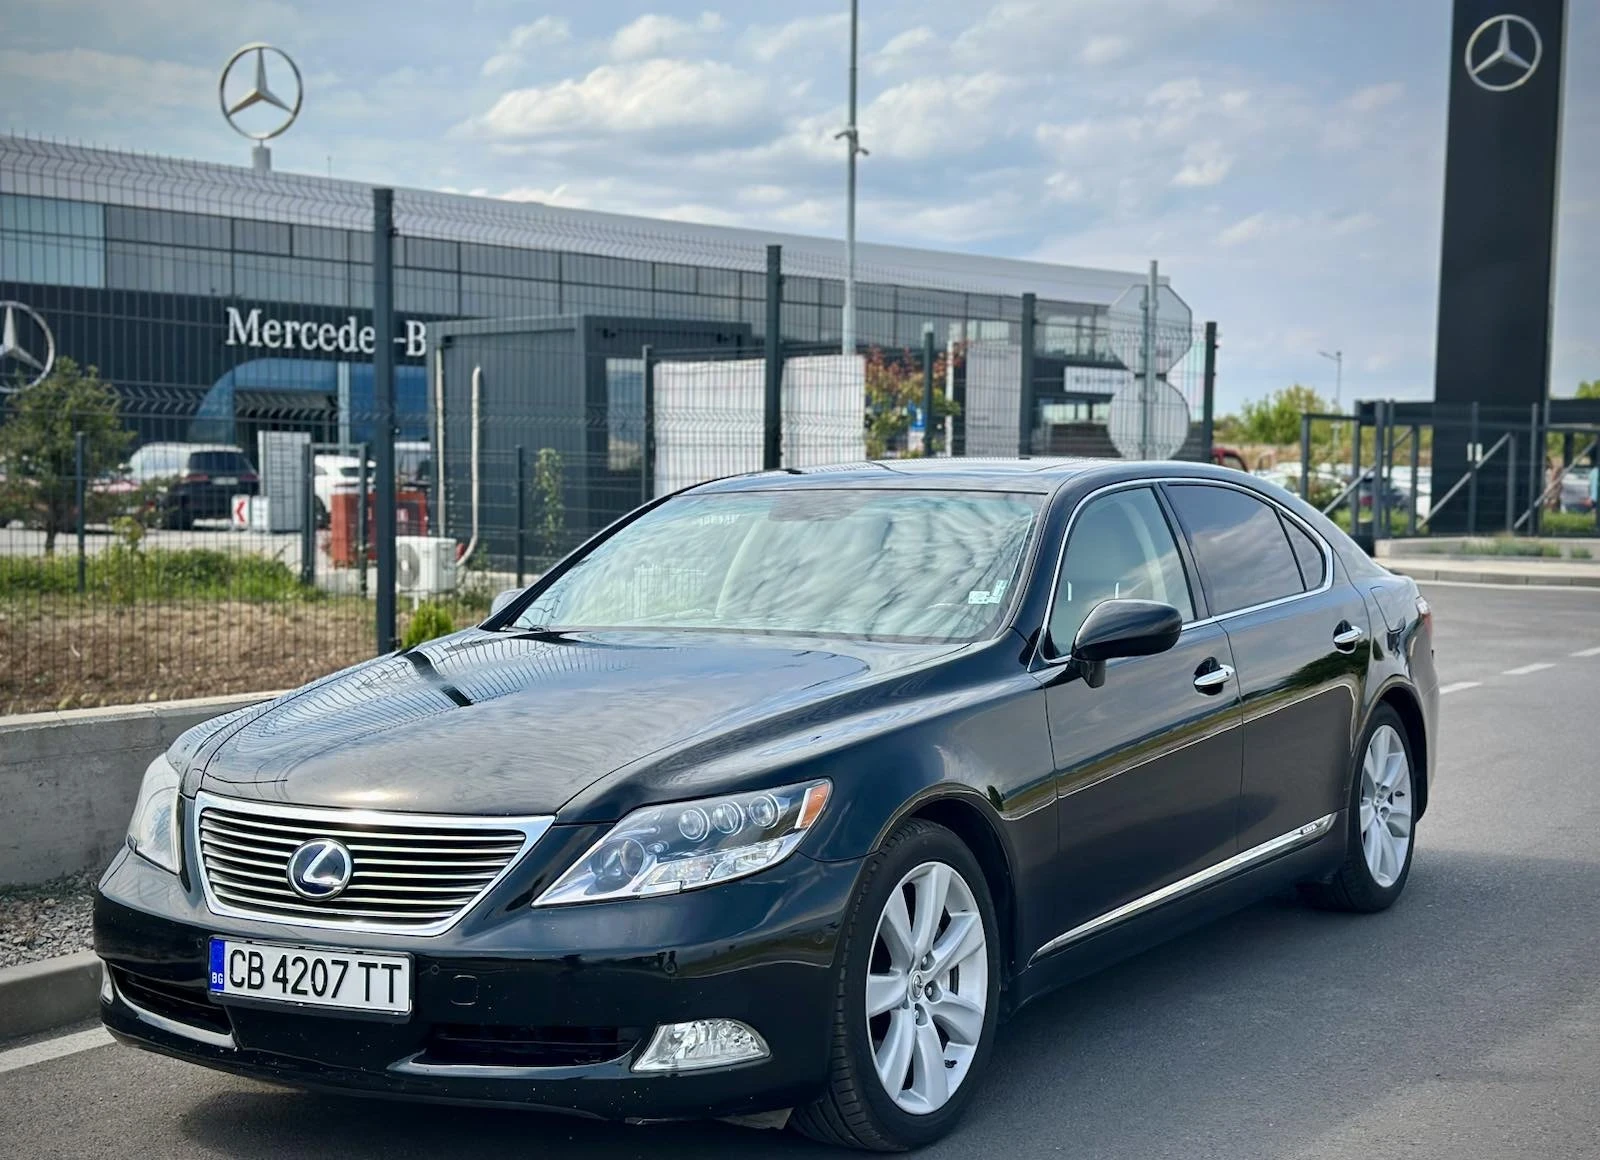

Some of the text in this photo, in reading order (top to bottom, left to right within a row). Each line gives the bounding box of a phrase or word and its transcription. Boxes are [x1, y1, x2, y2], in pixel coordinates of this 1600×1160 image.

[225, 307, 427, 357] Mercede-B
[211, 972, 224, 985] BG
[229, 949, 402, 1003] CB 4207 TT
